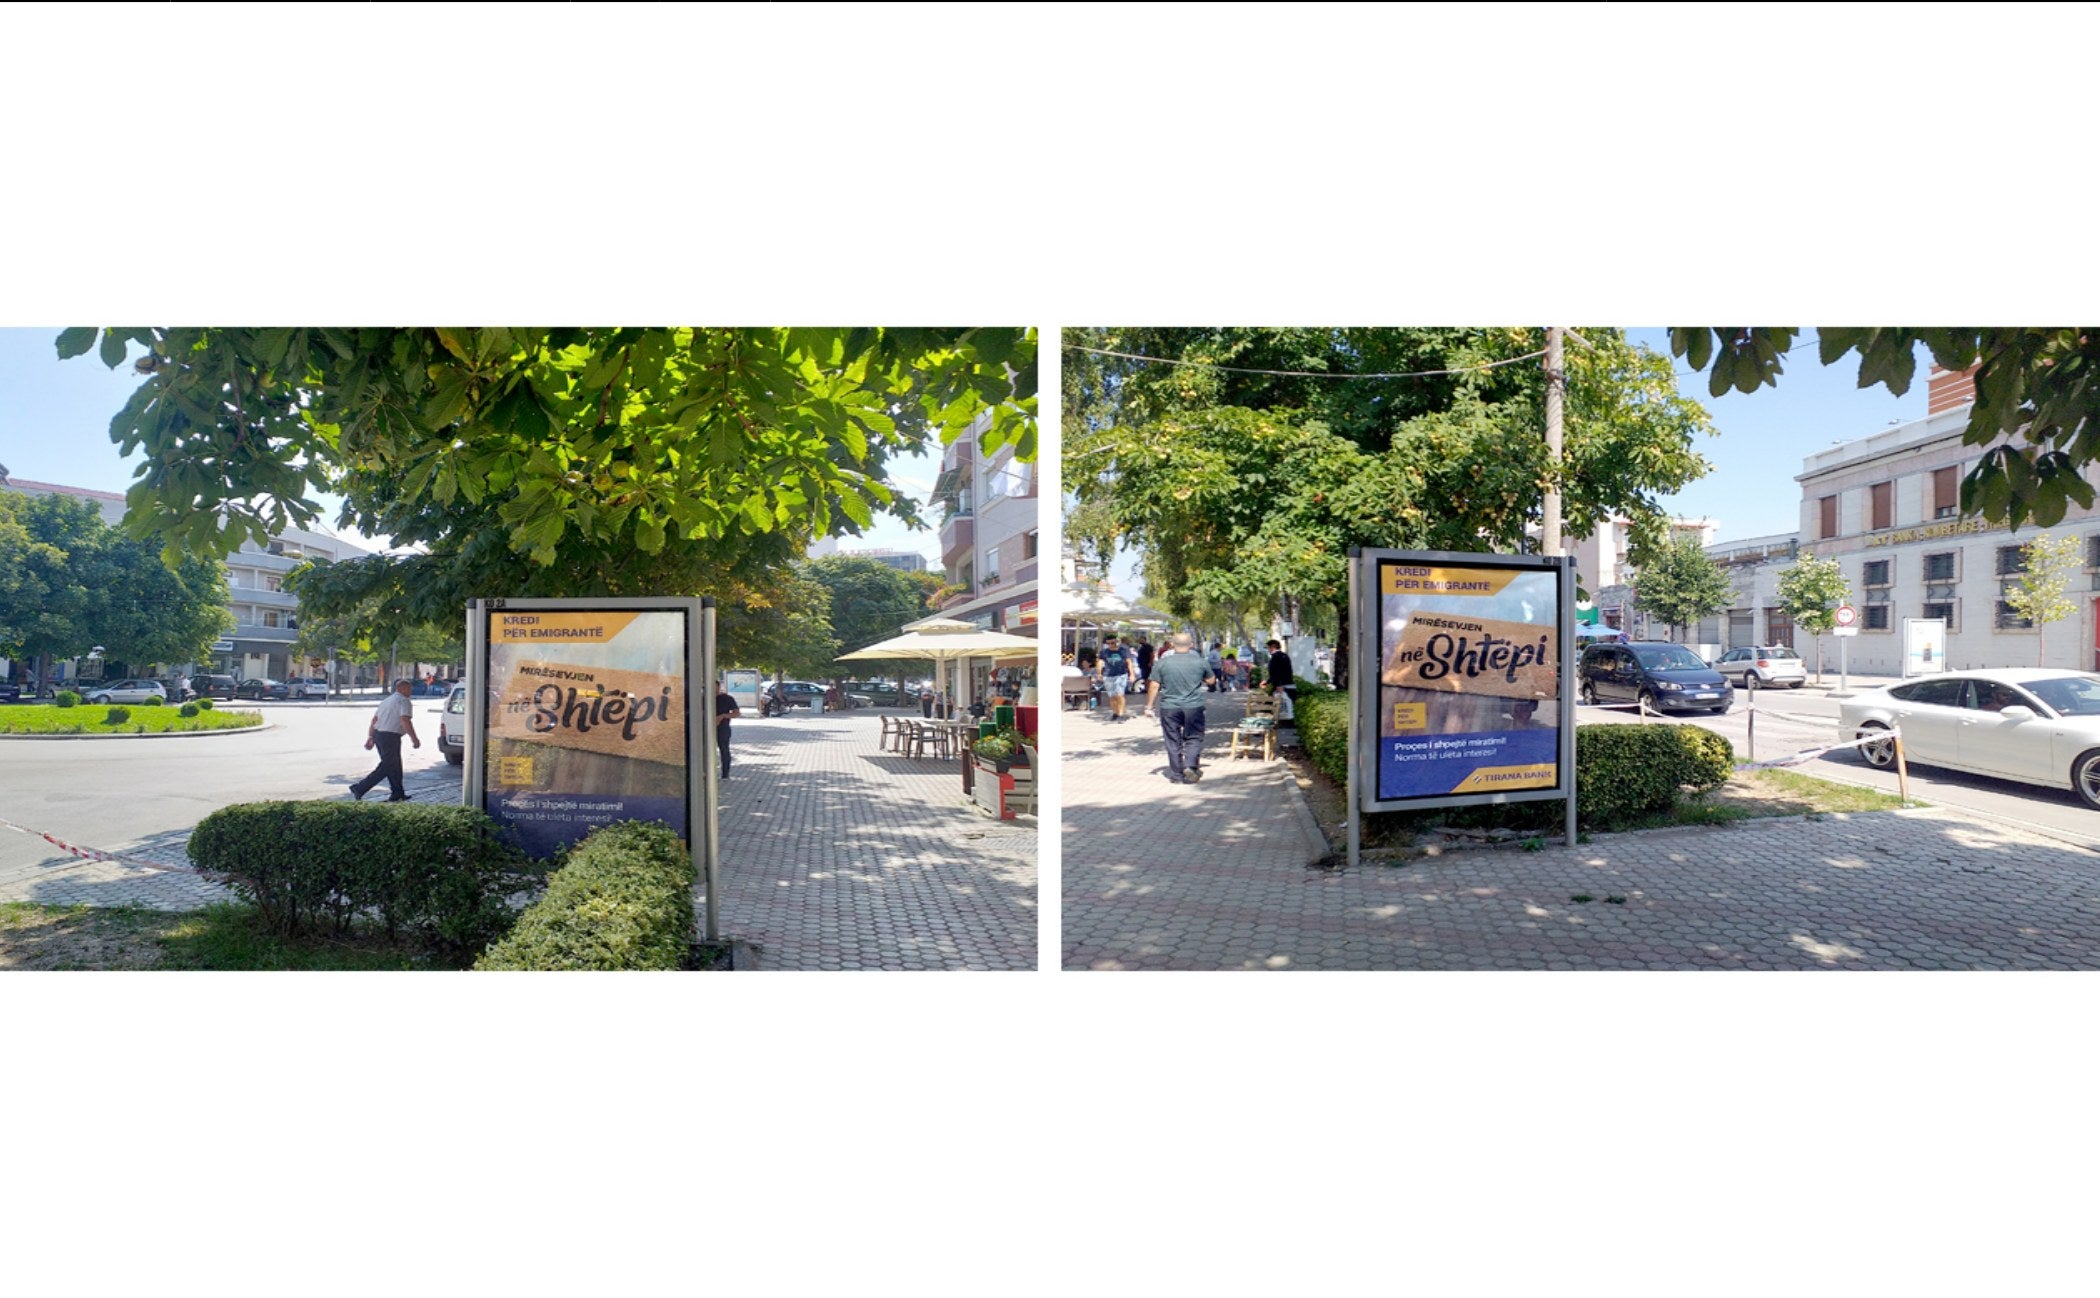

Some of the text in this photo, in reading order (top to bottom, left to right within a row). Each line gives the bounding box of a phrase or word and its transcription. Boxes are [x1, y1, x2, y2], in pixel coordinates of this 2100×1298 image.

[1395, 567, 1431, 577] KREDI
[503, 616, 540, 625] KREDI
[1412, 616, 1482, 632] MIRËSEVJEN
[503, 626, 603, 638] PËR EMIGRANTË
[1400, 633, 1547, 683] në Shtëpi
[519, 666, 594, 682] MIRËSEVJEN
[507, 683, 672, 741] në Shtëpi
[1484, 771, 1552, 782] TIRANA BANK
